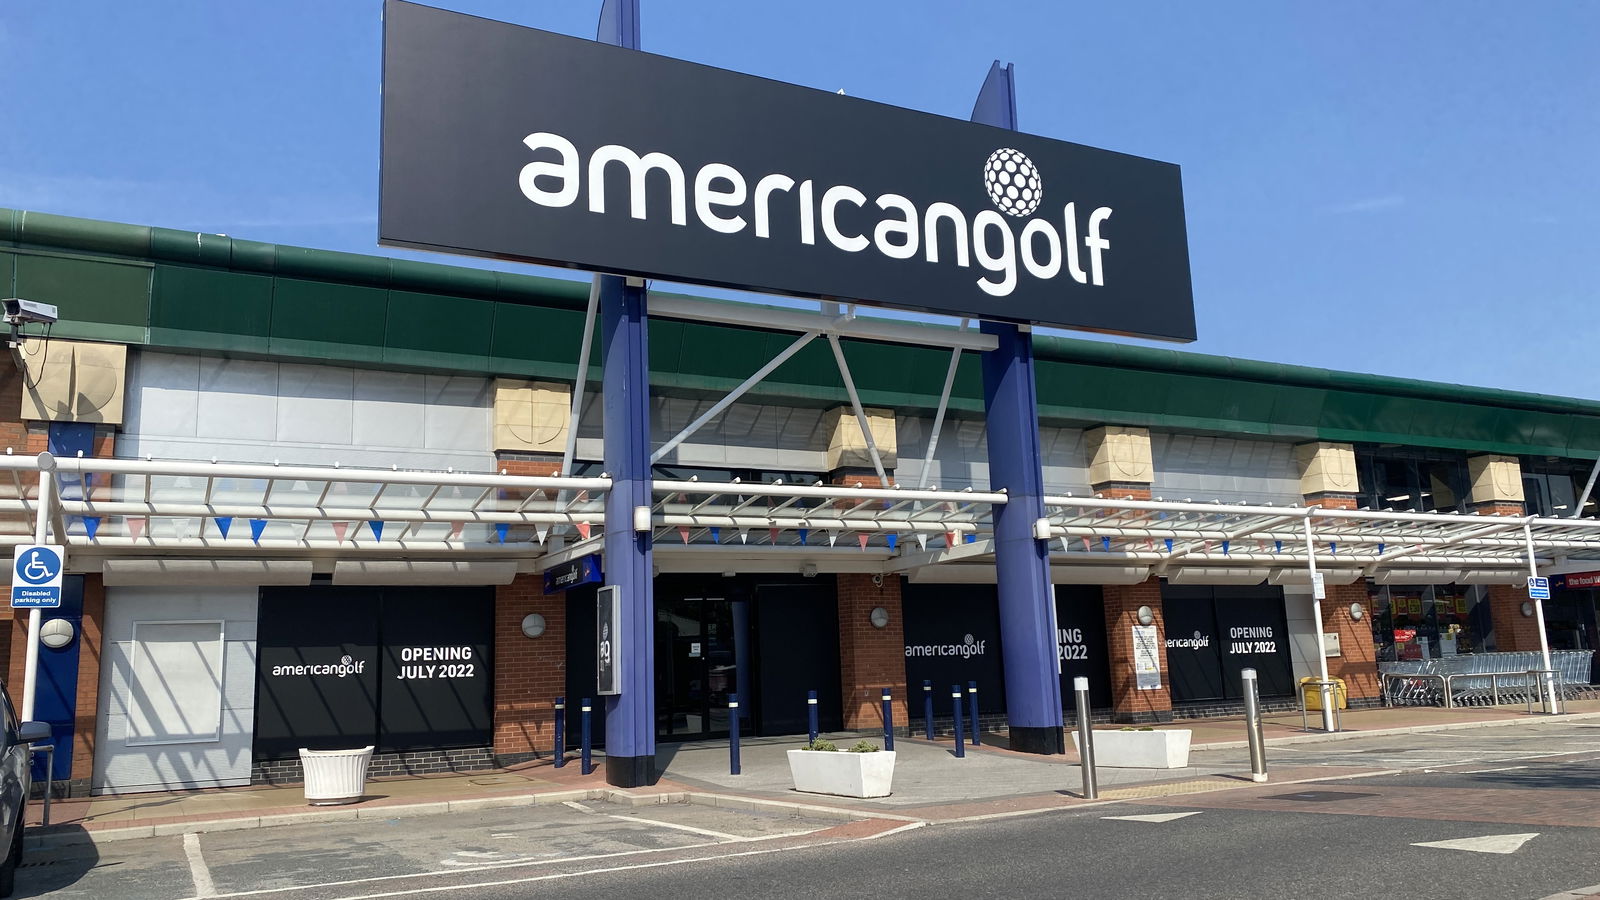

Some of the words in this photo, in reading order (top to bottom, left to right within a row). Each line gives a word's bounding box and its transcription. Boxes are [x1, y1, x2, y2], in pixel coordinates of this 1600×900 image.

[518, 131, 1112, 297] americangolf
[1230, 626, 1273, 639] OPENING
[905, 640, 986, 660] americangolf
[1164, 635, 1210, 650] ericangolf
[1229, 642, 1253, 654] JULY
[1254, 641, 1277, 653] 2022
[401, 646, 472, 662] OPENING
[272, 660, 365, 678] americangolf
[397, 665, 437, 680] JULY
[438, 664, 475, 678] 2022
